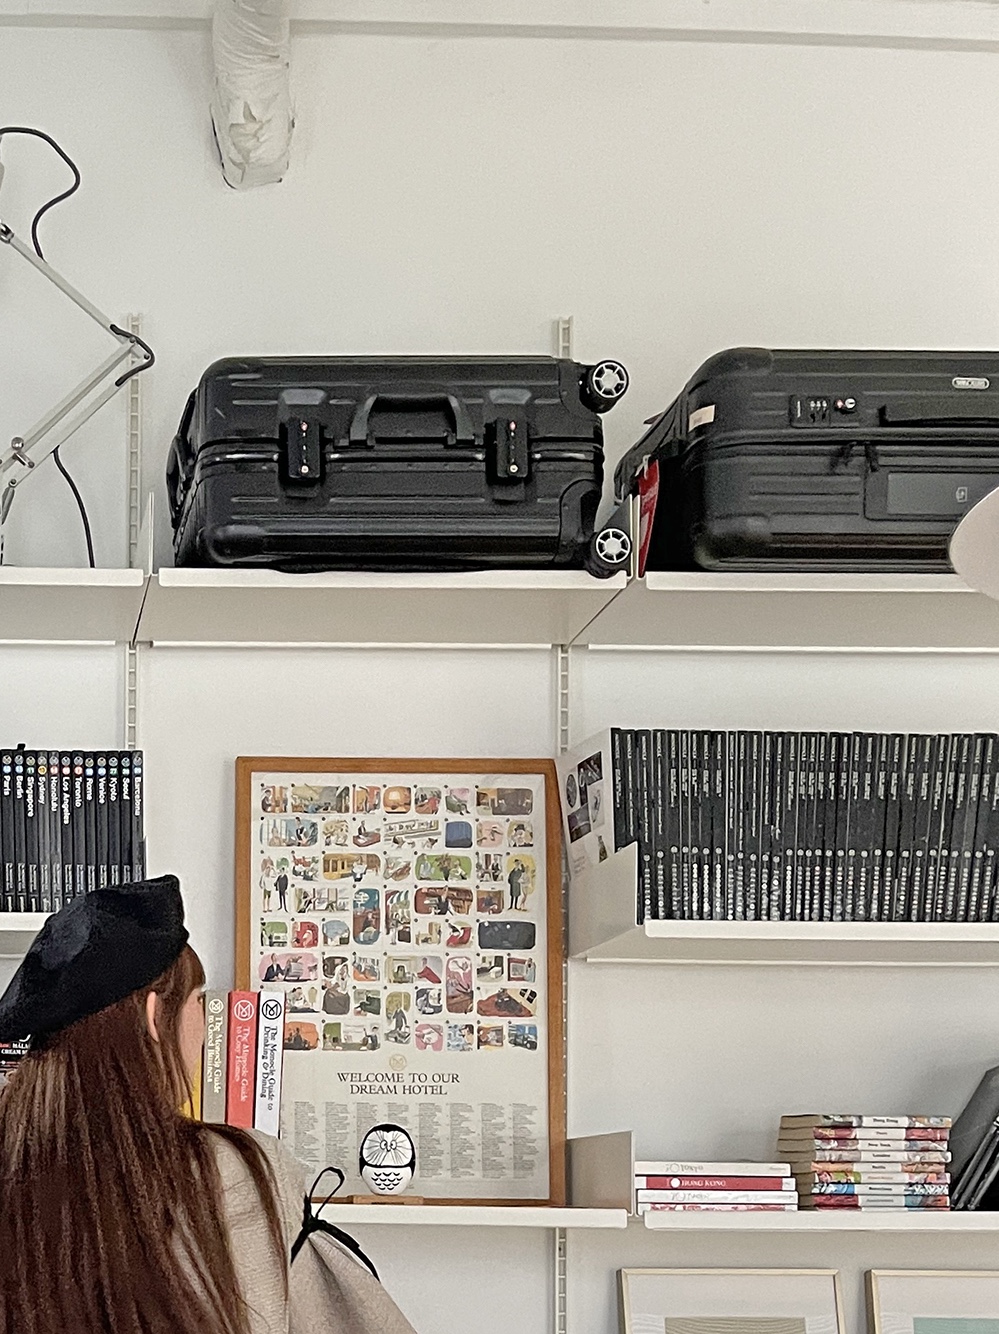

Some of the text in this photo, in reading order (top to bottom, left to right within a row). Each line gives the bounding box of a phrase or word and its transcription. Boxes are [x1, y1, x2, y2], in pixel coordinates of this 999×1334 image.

[262, 1026, 270, 1060] Drinking
[267, 1026, 278, 1111] The Monocle Guide to
[337, 1072, 460, 1084] WELCOME TO OUR
[260, 1072, 269, 1098] Dining
[350, 1084, 448, 1096] DREAM HOTEL
